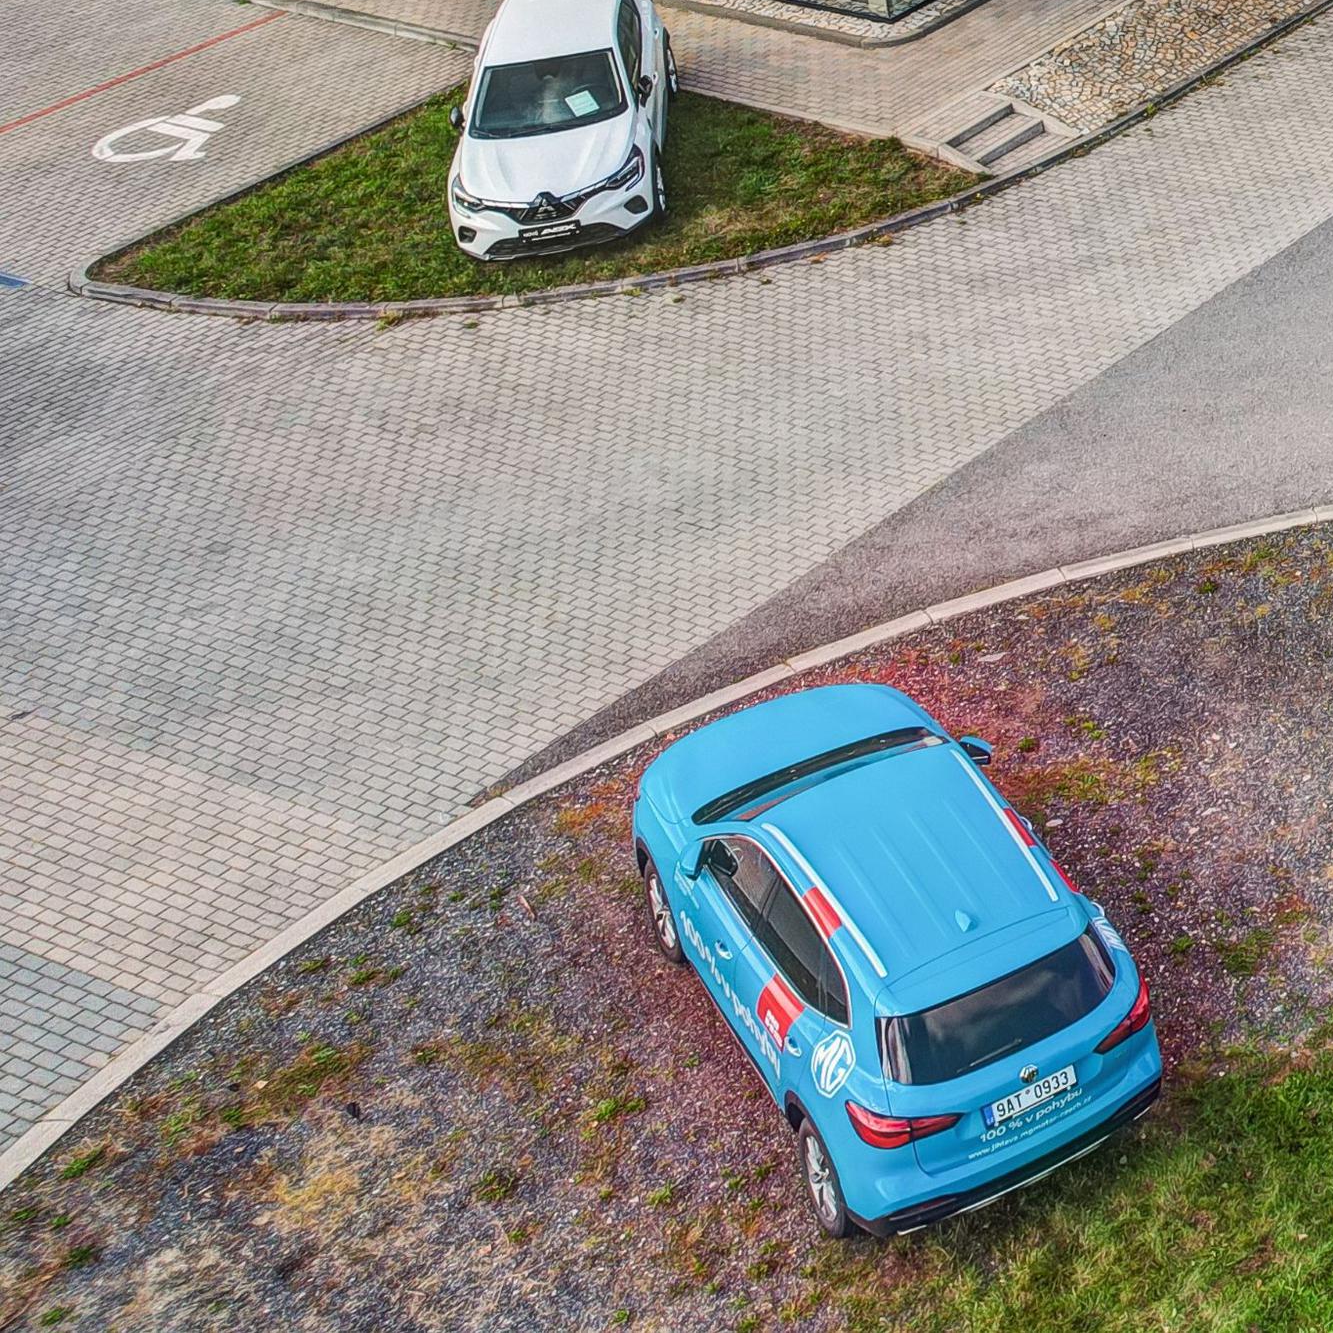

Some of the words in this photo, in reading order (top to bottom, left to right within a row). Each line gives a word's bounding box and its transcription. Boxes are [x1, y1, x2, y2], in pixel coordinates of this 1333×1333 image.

[813, 1034, 853, 1095] MG
[980, 1126, 1006, 1142] 100
[1035, 1088, 1083, 1121] pohybu
[996, 1093, 1022, 1117] 9AT
[1033, 1071, 1069, 1099] 0933
